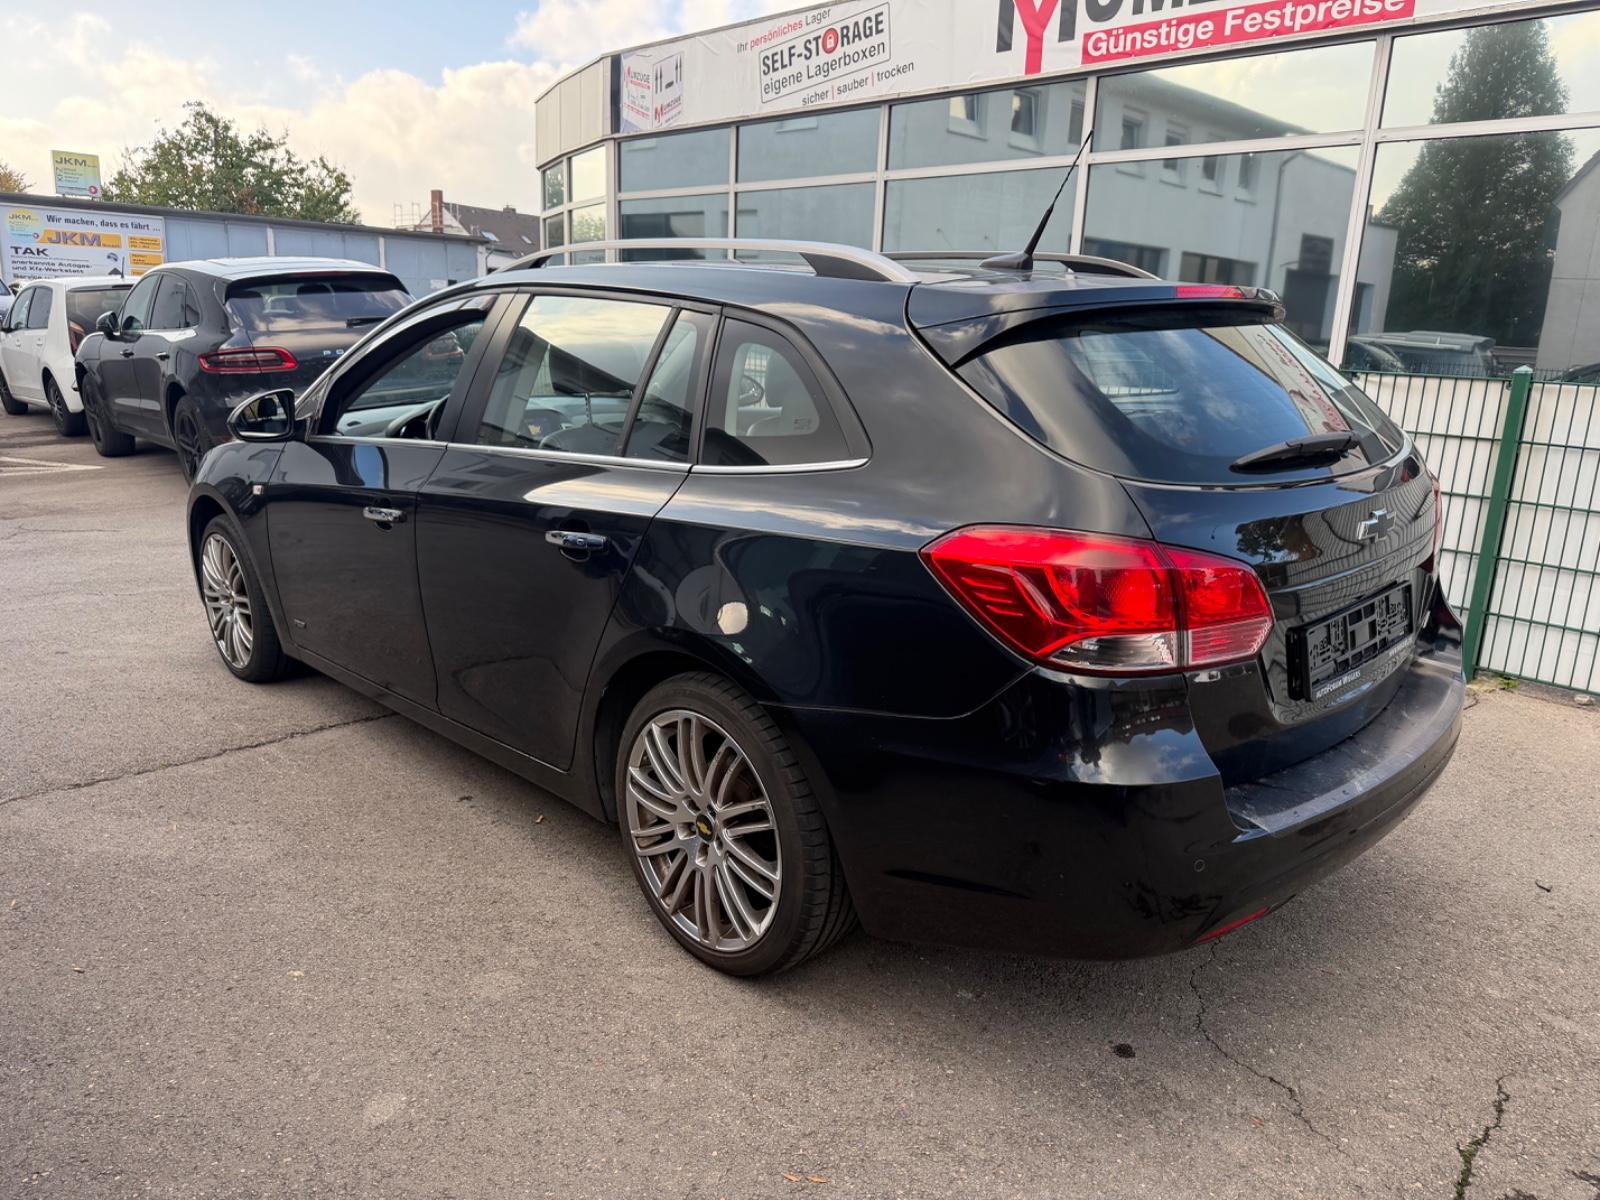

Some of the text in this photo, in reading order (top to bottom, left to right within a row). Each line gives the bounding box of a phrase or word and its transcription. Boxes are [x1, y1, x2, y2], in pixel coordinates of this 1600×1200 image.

[737, 8, 832, 53] Ihr persönliches Lager
[762, 12, 885, 76] SELF-STORAGE
[1087, 19, 1214, 57] Günstige
[1224, 0, 1404, 36] Festpreise
[763, 41, 885, 95] eigene Lagerboxen
[802, 61, 915, 106] sicher sauber trocken
[55, 156, 87, 167] JKM
[46, 214, 62, 223] Wir
[64, 216, 98, 227] machen,
[100, 219, 118, 228] dass
[47, 231, 102, 247] JKM
[10, 246, 49, 256] TAK
